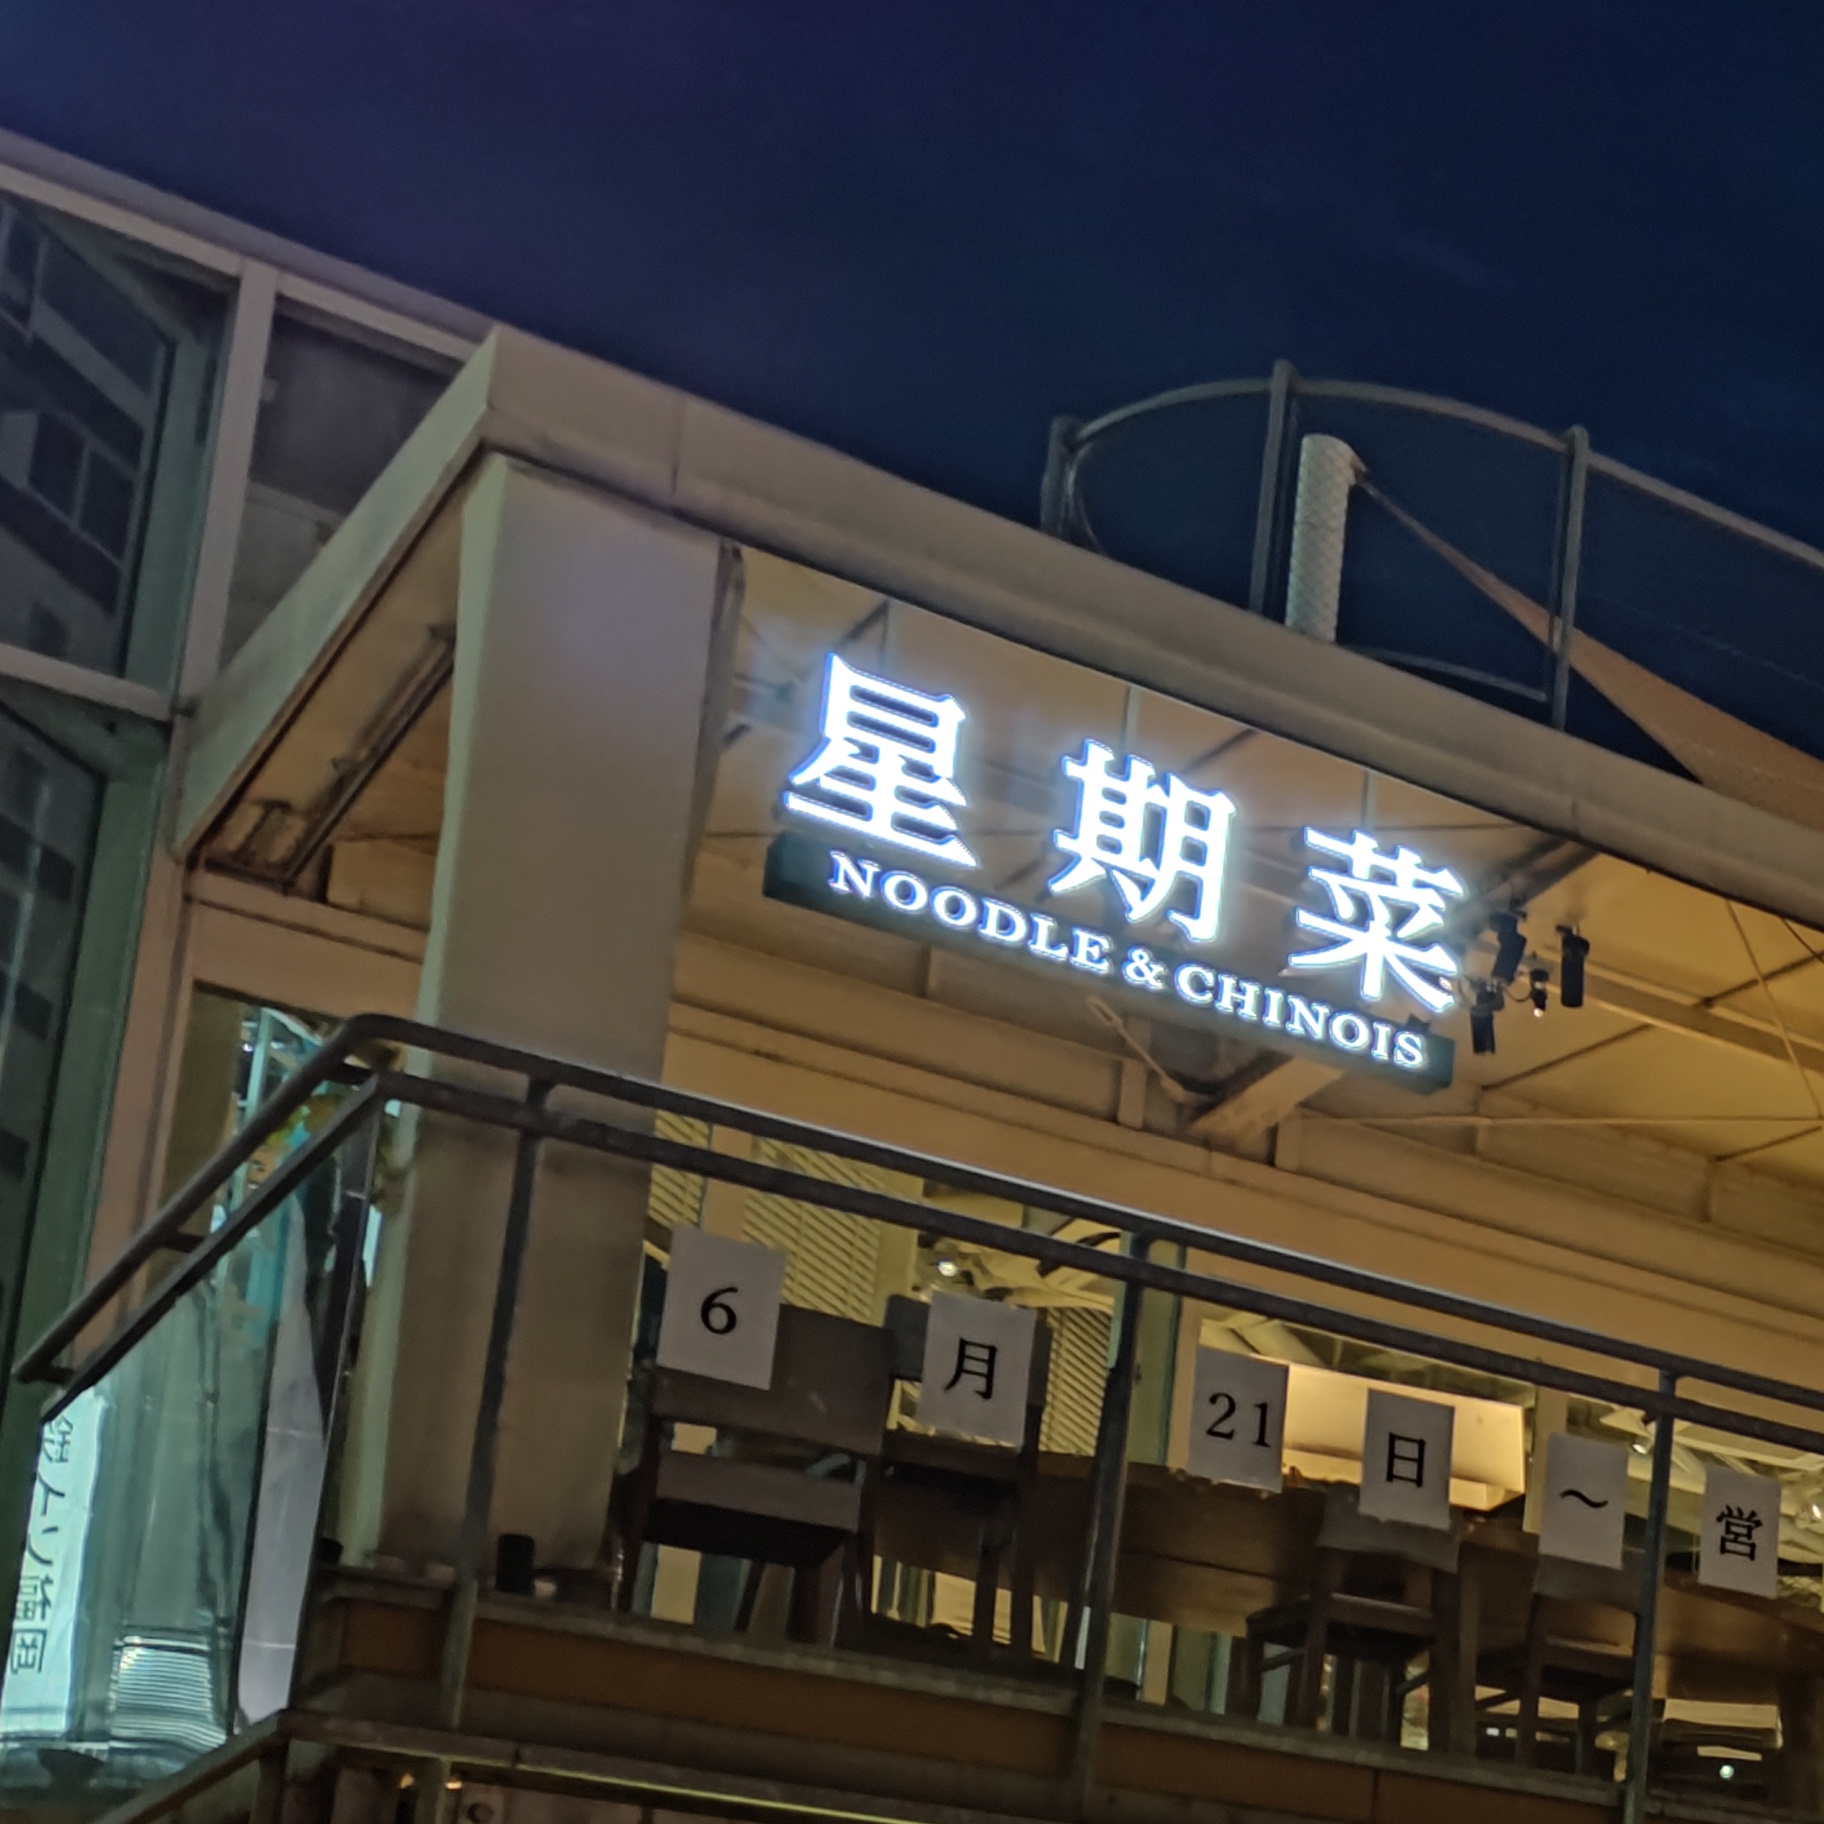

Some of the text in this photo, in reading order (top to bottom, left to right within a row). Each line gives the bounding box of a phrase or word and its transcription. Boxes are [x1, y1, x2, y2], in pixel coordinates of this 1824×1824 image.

[784, 652, 1464, 1013] 星期菜
[828, 850, 1430, 1070] NOODLE & CHINOIS
